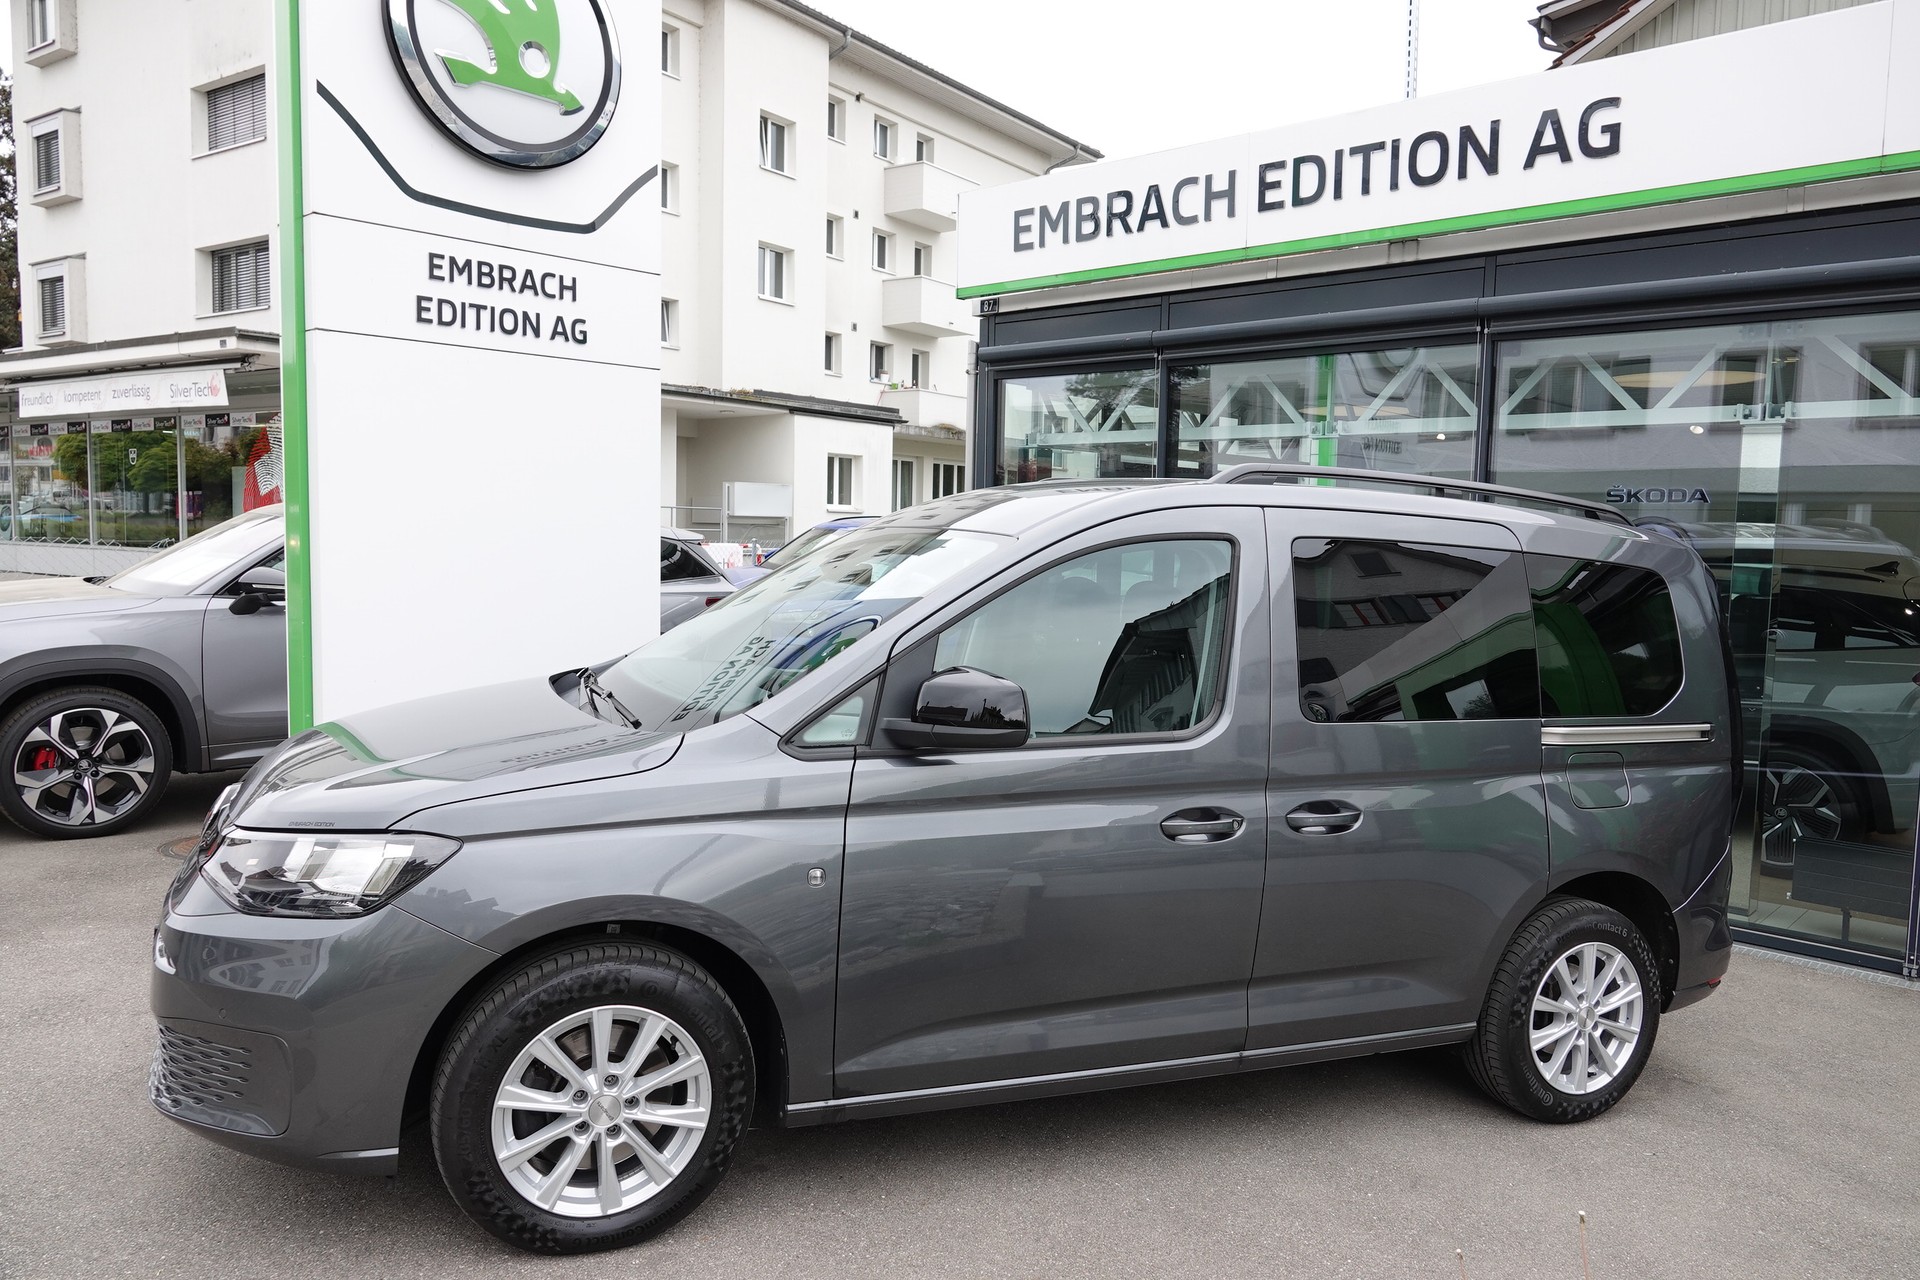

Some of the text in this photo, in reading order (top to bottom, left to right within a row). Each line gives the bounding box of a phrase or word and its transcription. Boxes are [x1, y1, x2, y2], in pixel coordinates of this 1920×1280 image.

[1013, 96, 1622, 253] EMBRACH EDITION AG
[428, 252, 577, 302] EMBRACH
[416, 295, 587, 344] EDITION AG
[21, 391, 54, 407] freundlich
[63, 390, 102, 404] kompetent
[1606, 485, 1711, 504] ŠKODA
